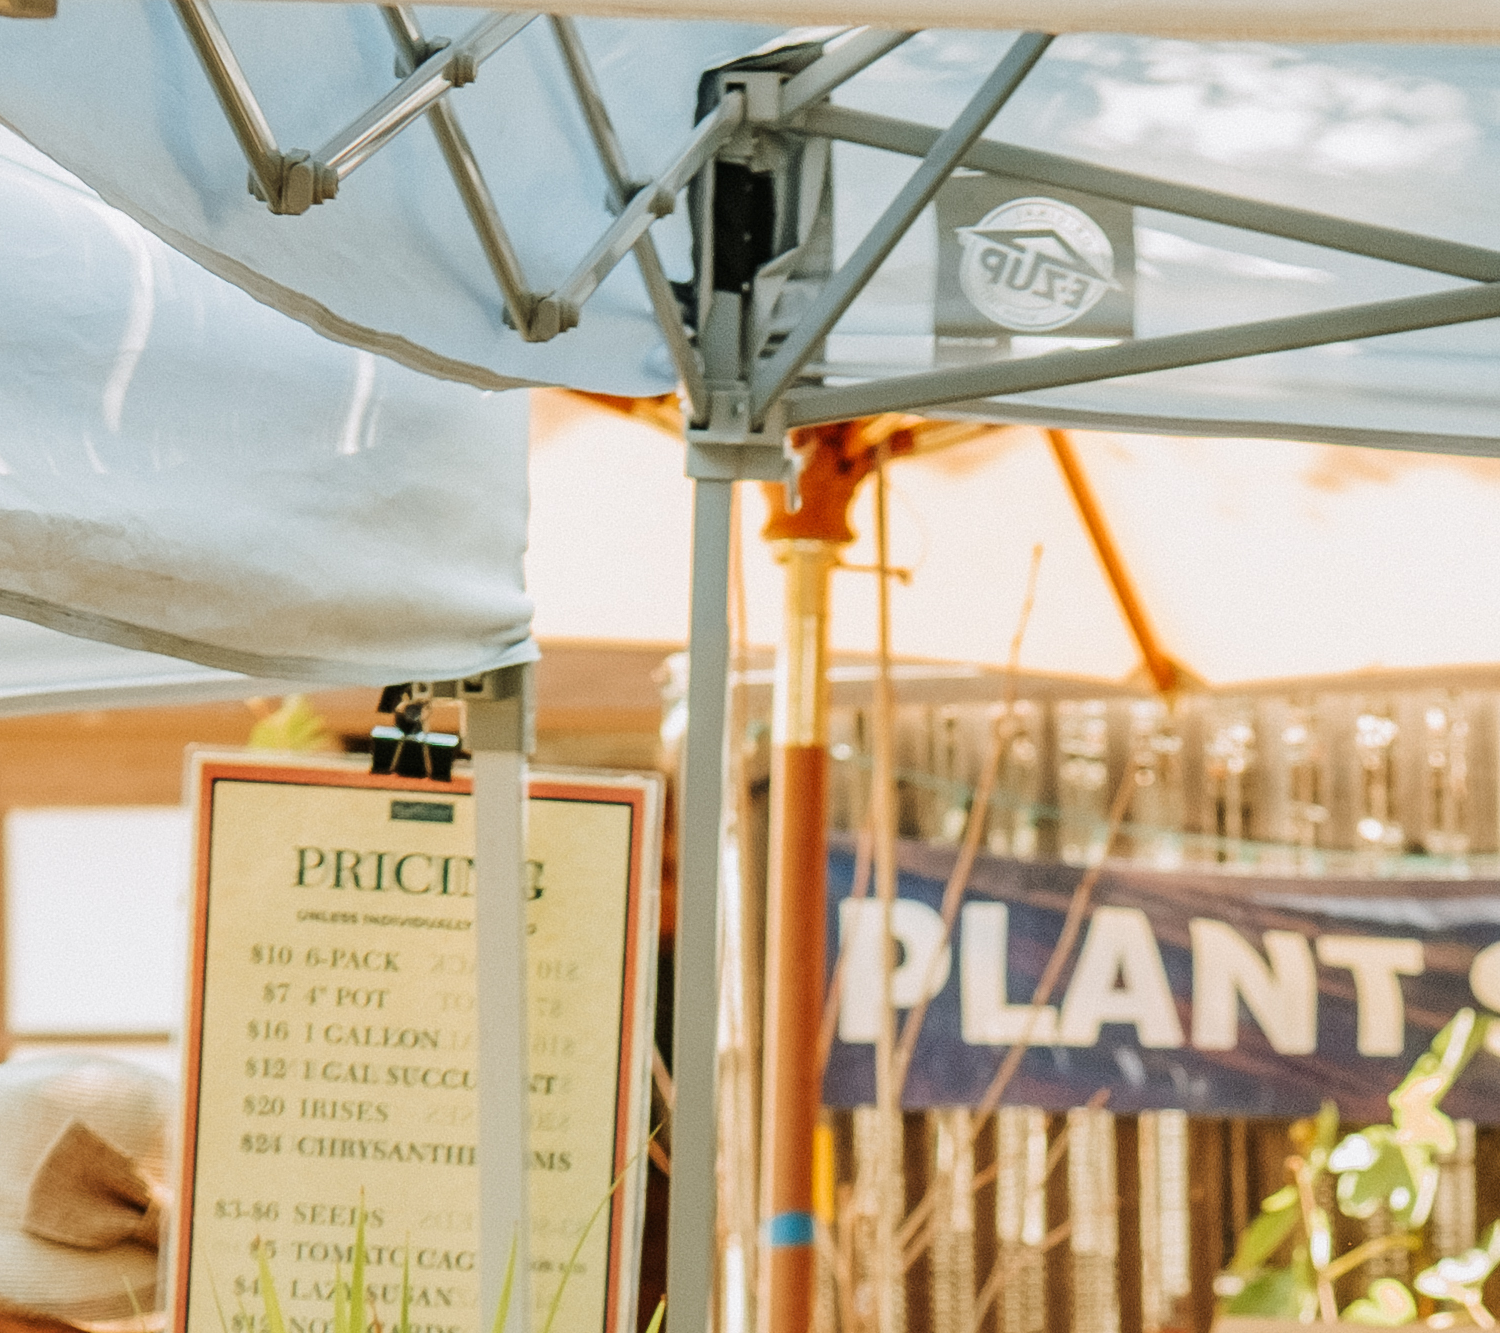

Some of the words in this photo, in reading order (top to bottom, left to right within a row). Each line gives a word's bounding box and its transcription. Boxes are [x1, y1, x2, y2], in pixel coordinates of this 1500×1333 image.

[251, 943, 293, 966] $10
[305, 946, 399, 973] 6-PACK
[839, 898, 1424, 1056] PLANT
[263, 981, 291, 1004] $7
[336, 986, 390, 1010] POT
[247, 1019, 290, 1042] $16
[323, 1022, 441, 1050] GALLON
[245, 1056, 287, 1080] $12
[322, 1060, 378, 1085] GAL
[387, 1064, 557, 1096] SUCCUT
[243, 1094, 286, 1117] $20
[301, 1098, 390, 1124] IRISES
[241, 1133, 284, 1156] $24
[297, 1134, 573, 1172] CHRYSANTHMS
[214, 1200, 280, 1223] $3-$6
[294, 1203, 385, 1228] SEEDS
[417, 1248, 475, 1272] CAG
